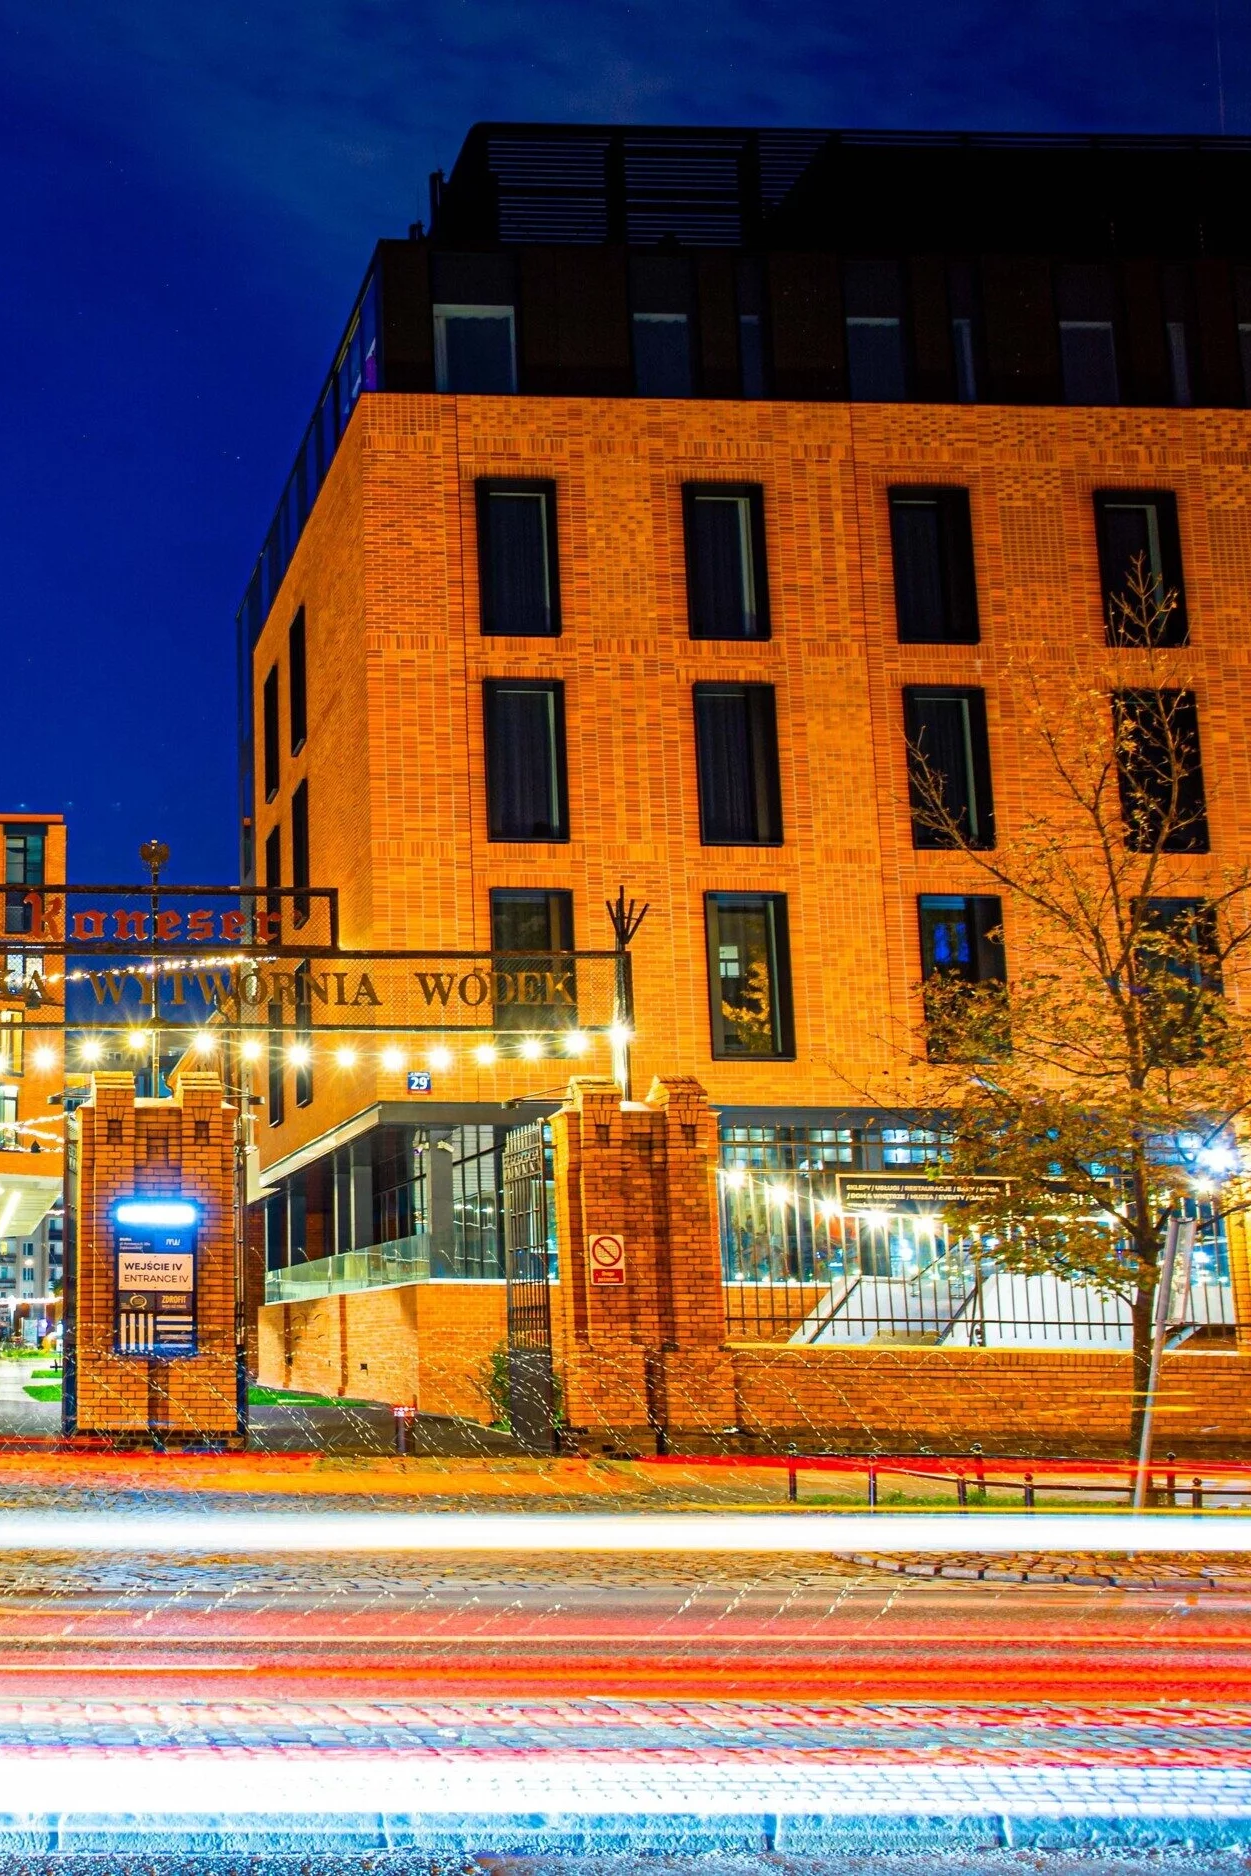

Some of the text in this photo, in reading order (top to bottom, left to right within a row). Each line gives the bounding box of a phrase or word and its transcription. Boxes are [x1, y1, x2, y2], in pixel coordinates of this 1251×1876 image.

[24, 891, 282, 942] Koneser
[90, 967, 382, 1006] WYTWÓRNIA
[414, 967, 577, 1006] WÓDEK
[410, 1076, 428, 1090] 29
[124, 1260, 183, 1271] WEJŚCIE IV
[124, 1274, 189, 1283] ENTRANCE IV
